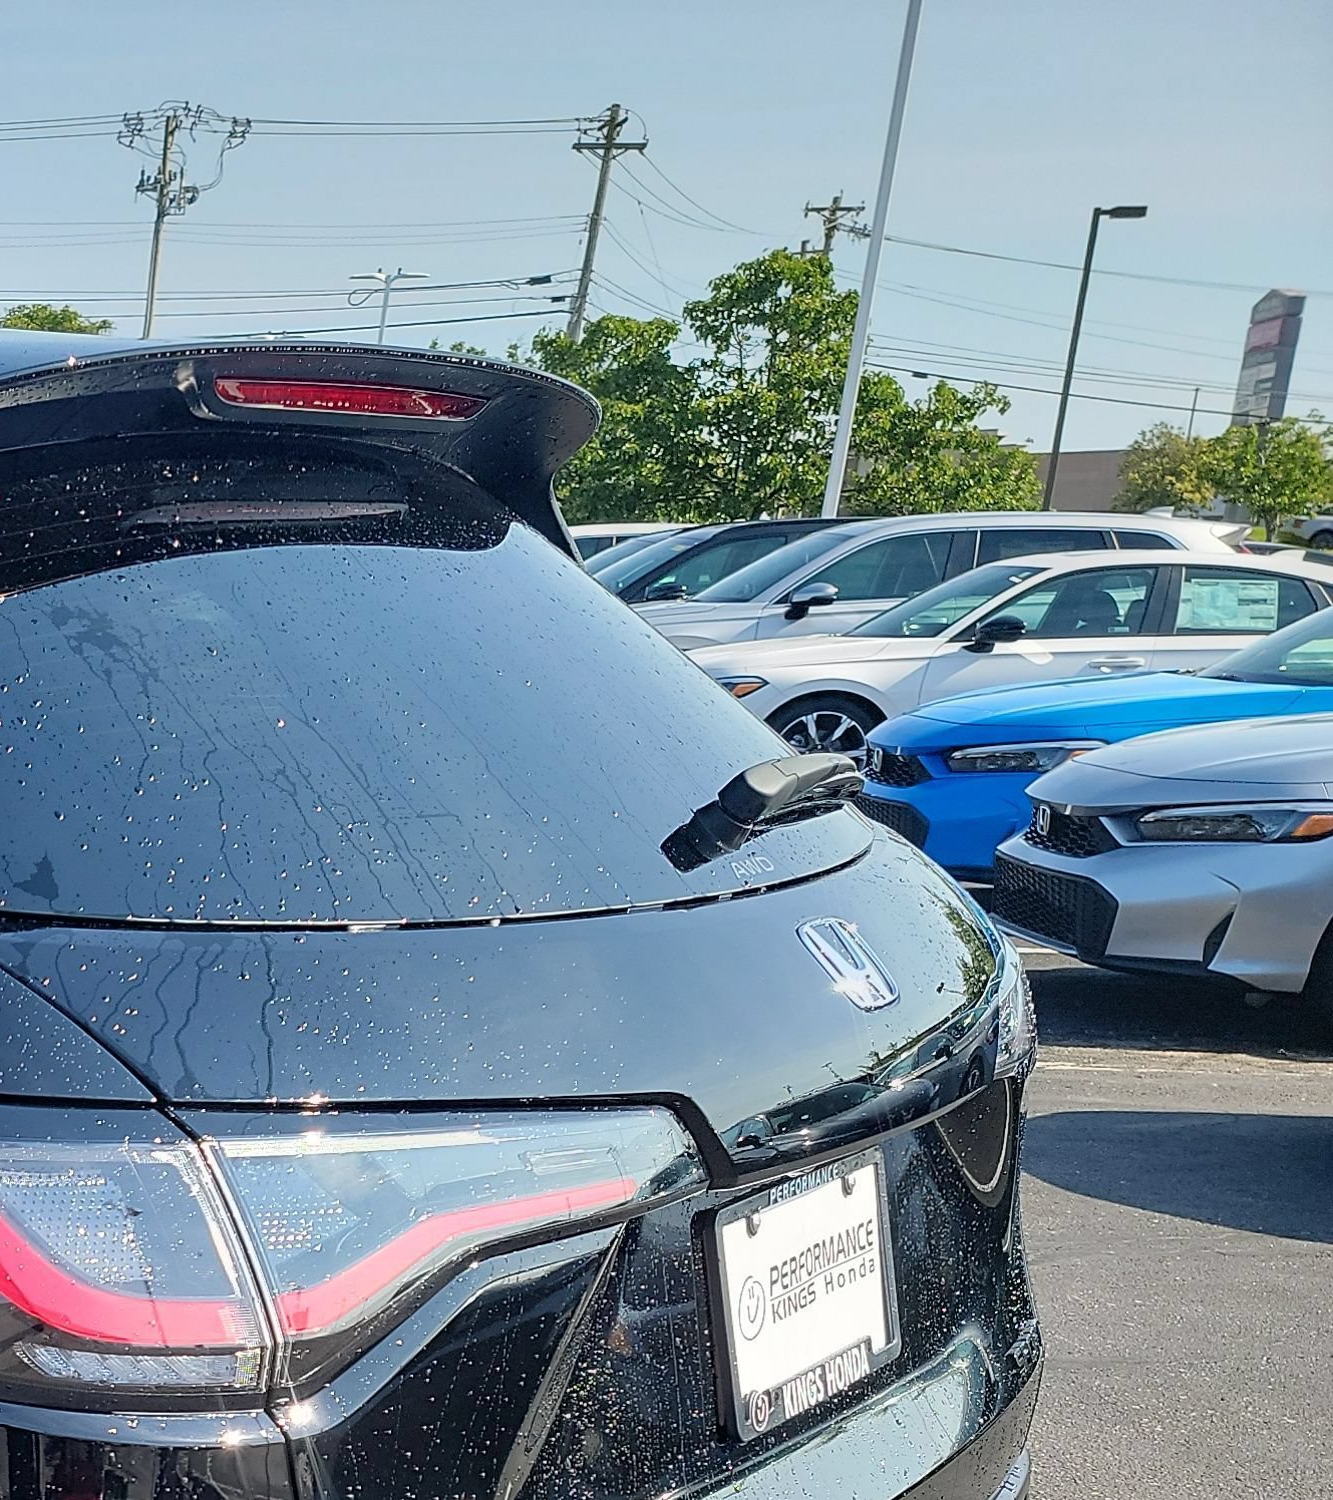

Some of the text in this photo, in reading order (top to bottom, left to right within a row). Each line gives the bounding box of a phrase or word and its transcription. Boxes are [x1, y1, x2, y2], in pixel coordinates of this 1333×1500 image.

[730, 855, 775, 879] AWD
[769, 1162, 839, 1206] PERFORMANCE
[769, 1218, 874, 1297] PERFORMANCE
[771, 1257, 875, 1324] KINGS Honda
[781, 1343, 871, 1420] KINGS HONDA
